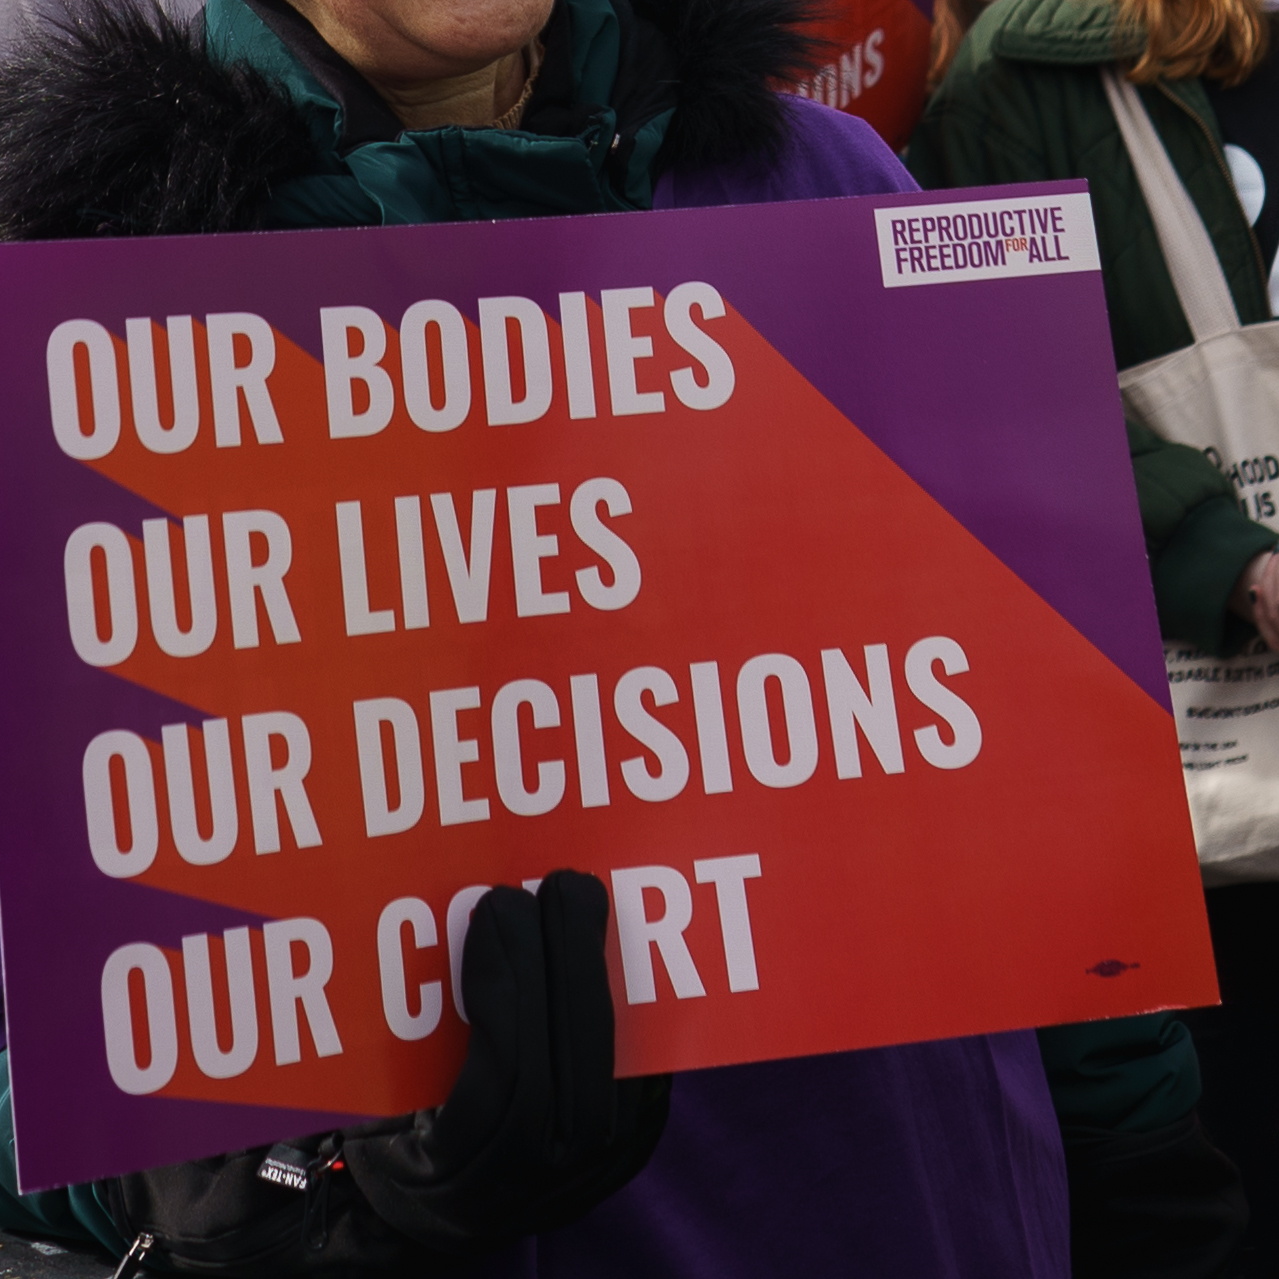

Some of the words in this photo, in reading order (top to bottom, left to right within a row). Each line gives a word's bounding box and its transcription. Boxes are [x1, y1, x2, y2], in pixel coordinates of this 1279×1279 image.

[891, 206, 1065, 246] REPRODUCTIVE
[895, 240, 1006, 274] FREEDOM
[1006, 237, 1029, 252] FOR
[1029, 235, 1069, 263] ALL
[46, 312, 284, 460] OUR
[321, 280, 737, 439] BODIES
[63, 510, 301, 666] OUR
[337, 476, 644, 637] LIVES
[82, 711, 323, 878] OUR
[353, 635, 983, 837] DECISIONS
[100, 917, 342, 1096] OUR
[377, 852, 764, 1041] CRT
